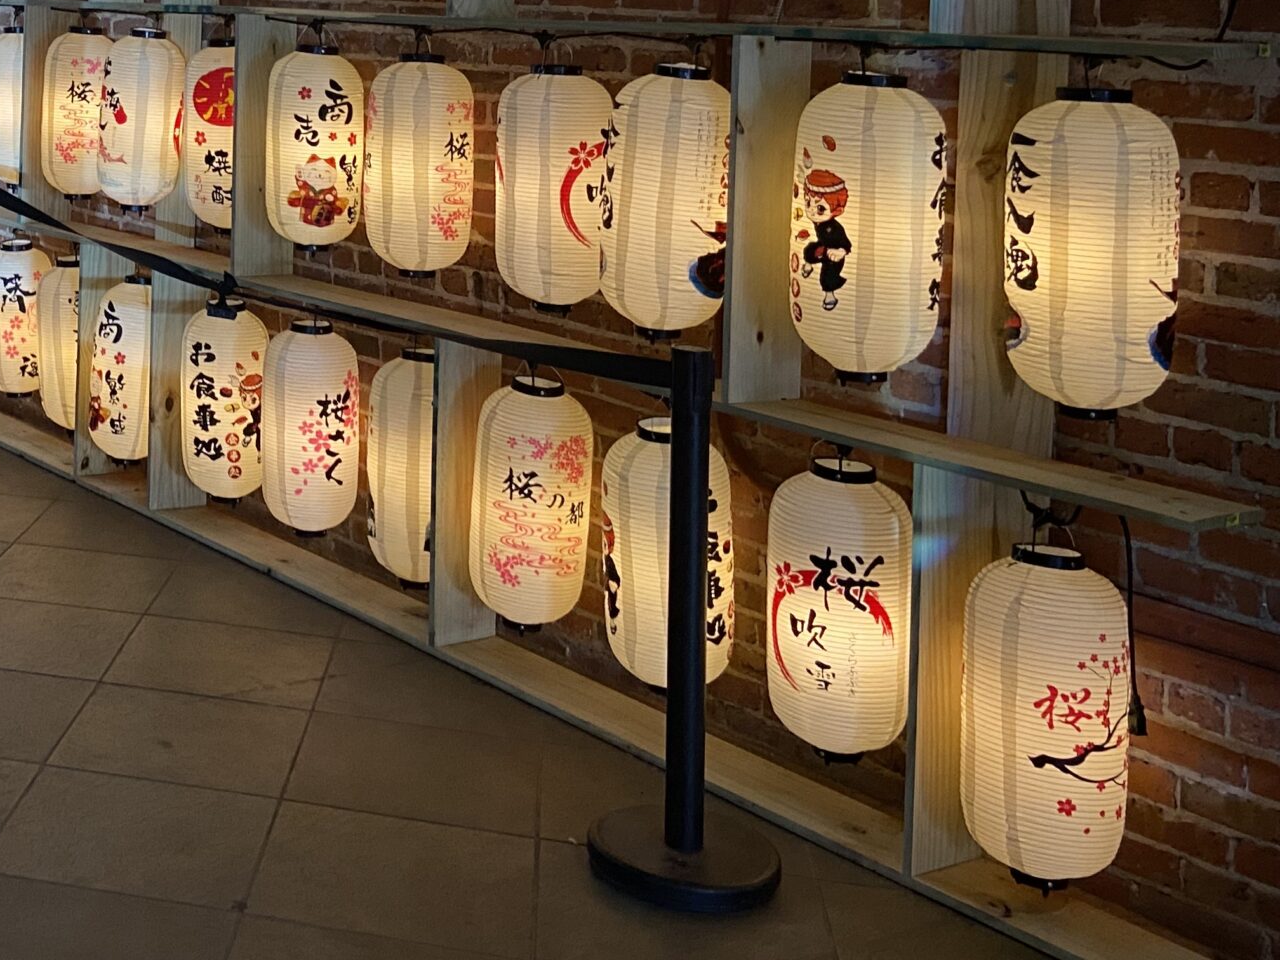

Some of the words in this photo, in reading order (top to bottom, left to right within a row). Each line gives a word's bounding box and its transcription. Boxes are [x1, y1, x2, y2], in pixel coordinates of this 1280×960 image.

[789, 547, 886, 693] 桜吹雪
[1033, 684, 1093, 732] 桜
